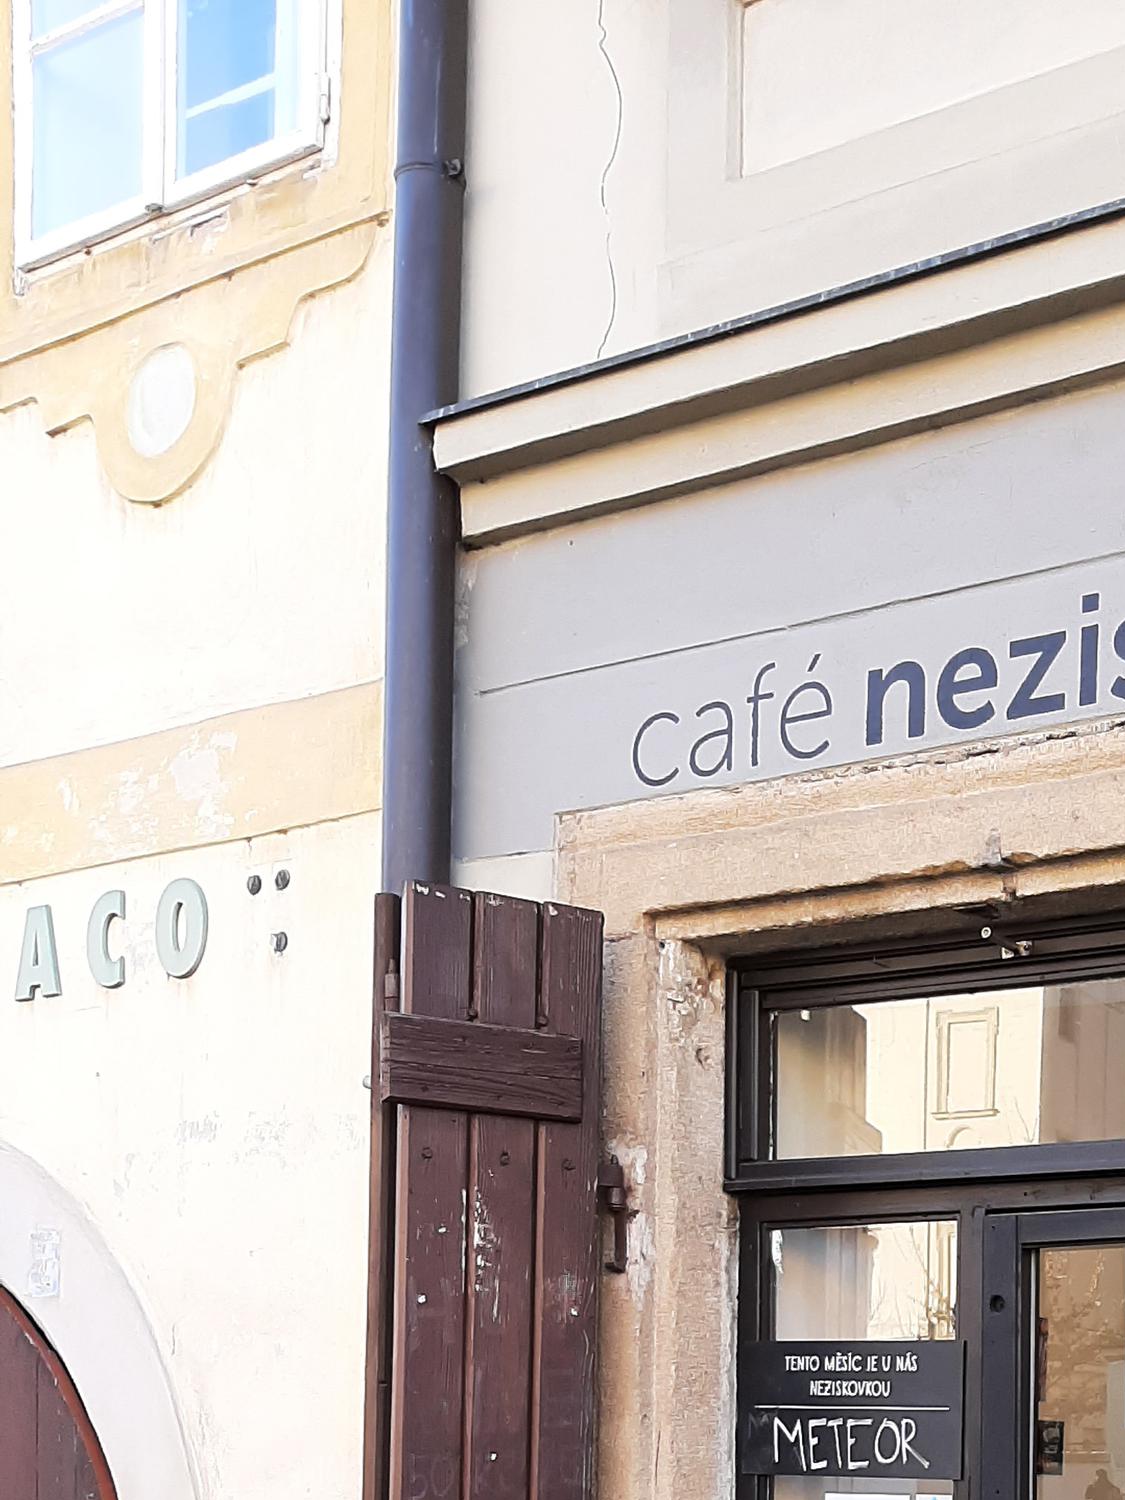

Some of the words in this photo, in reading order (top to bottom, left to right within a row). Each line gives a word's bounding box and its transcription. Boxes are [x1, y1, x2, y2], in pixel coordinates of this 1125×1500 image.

[632, 653, 832, 787] café
[784, 1354, 820, 1372] TENTO
[866, 1355, 879, 1372] JE
[881, 1355, 891, 1372] U
[895, 1351, 918, 1372] NÁS
[809, 1380, 891, 1397] NEZISKOVKOU
[773, 1416, 930, 1472] METEOR
